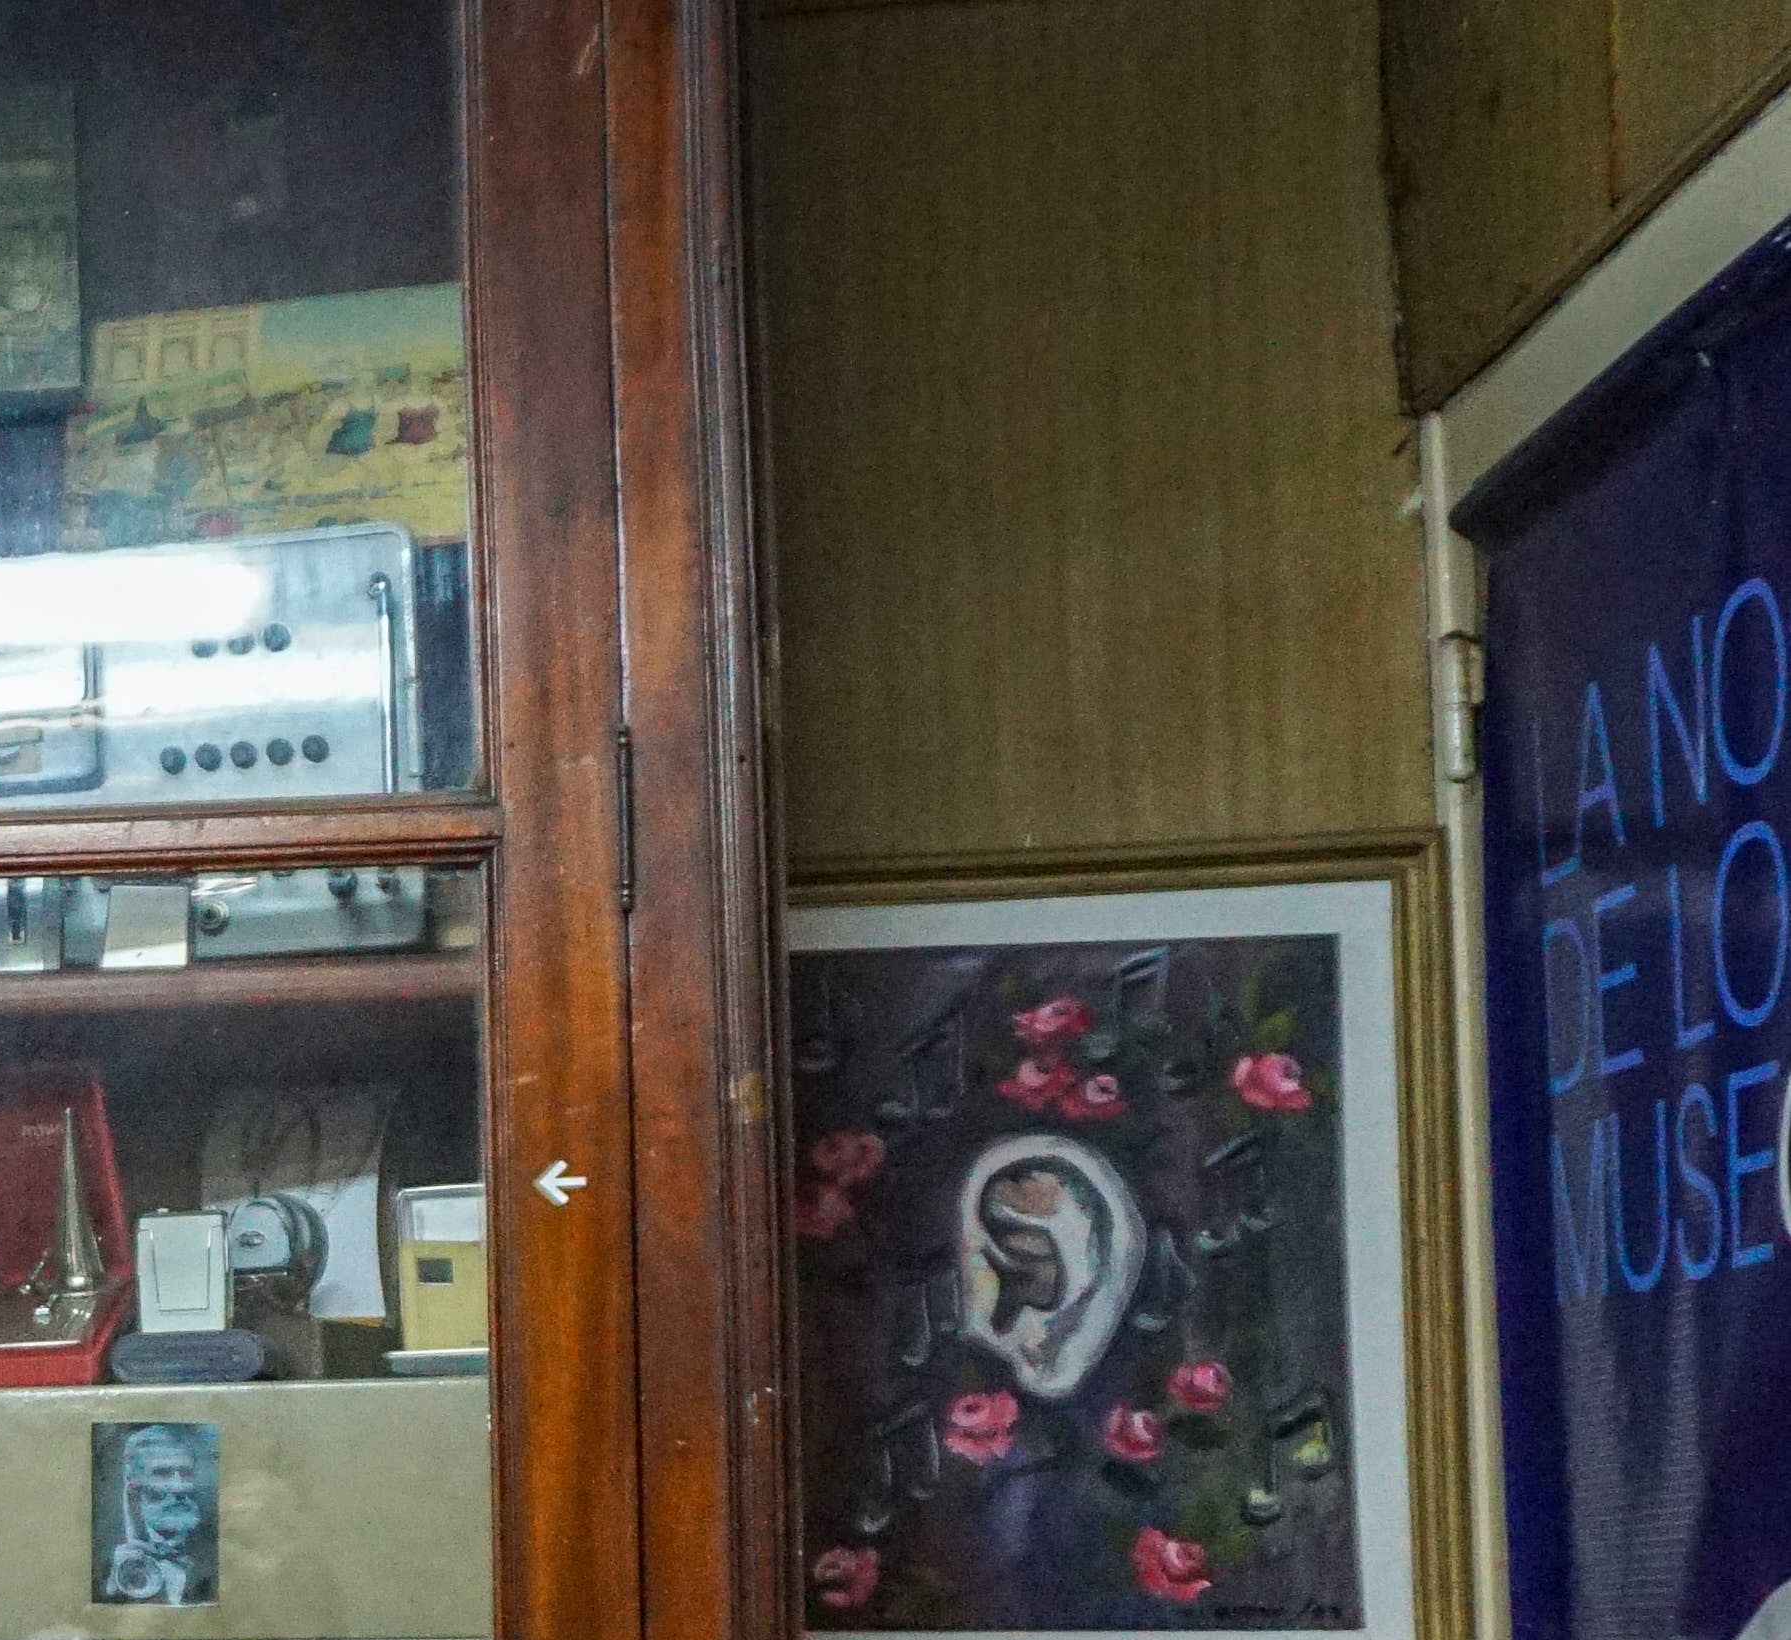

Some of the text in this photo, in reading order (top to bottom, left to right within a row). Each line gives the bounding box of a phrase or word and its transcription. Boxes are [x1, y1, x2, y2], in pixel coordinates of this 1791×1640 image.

[1530, 680, 1626, 888] LA
[1542, 884, 1645, 1098] DE
[1550, 1060, 1791, 1302] MUSE
